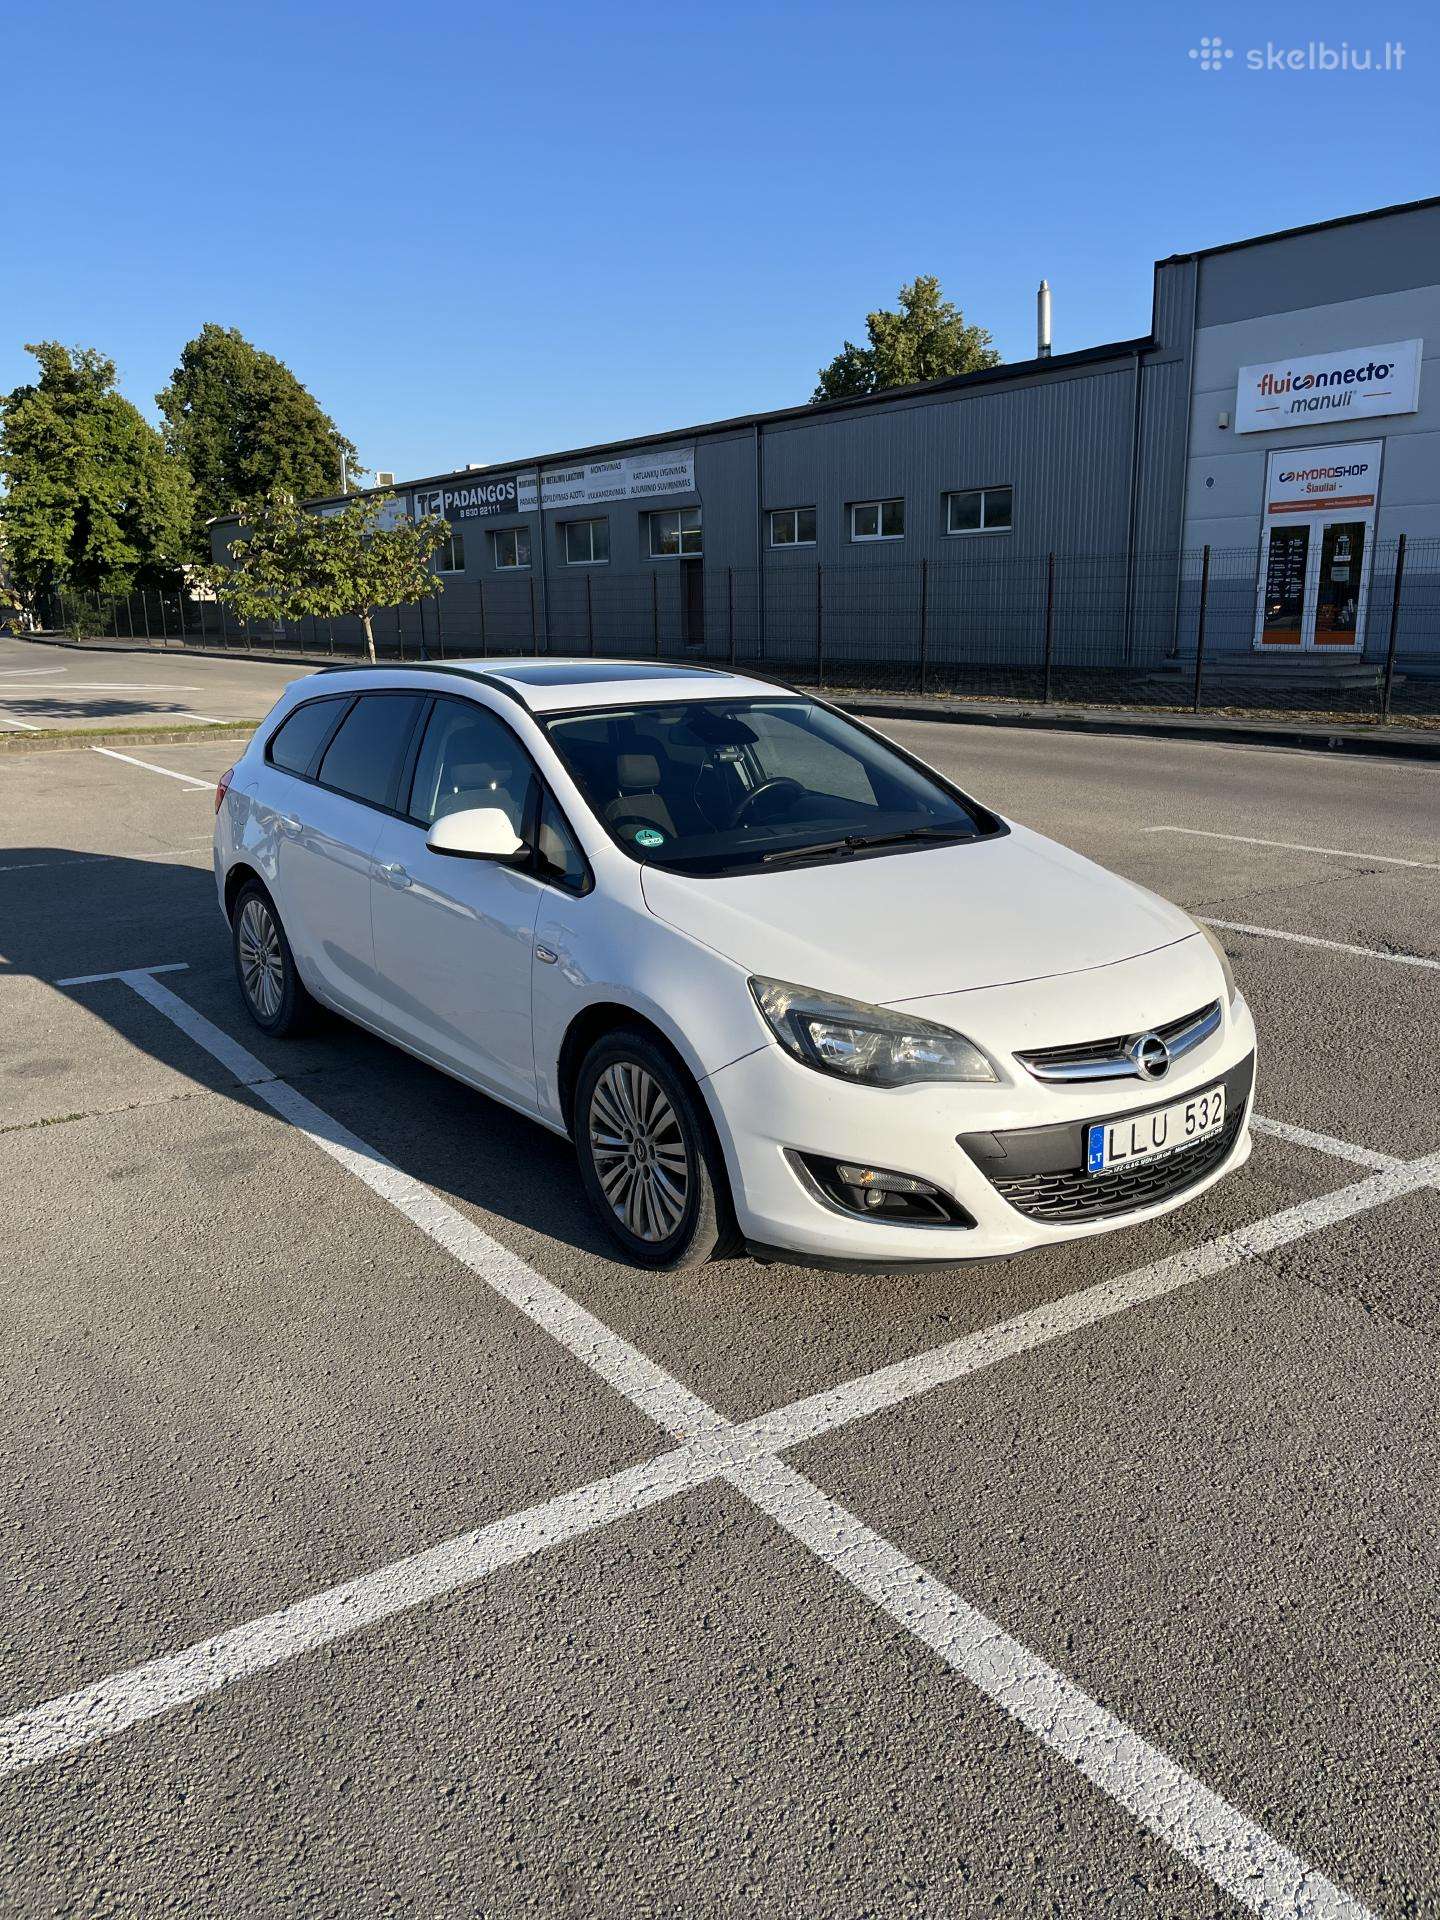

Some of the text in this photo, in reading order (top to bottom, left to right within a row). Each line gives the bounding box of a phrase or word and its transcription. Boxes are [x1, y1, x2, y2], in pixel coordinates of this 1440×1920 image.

[1291, 391, 1352, 413] manuli
[1296, 464, 1368, 482] HYDROSHOP
[445, 482, 515, 509] PADANGOS
[1306, 482, 1337, 493] Šiauliai
[480, 505, 500, 516] 22111
[1108, 1092, 1223, 1162] LLU 532
[1089, 1151, 1102, 1165] LT
